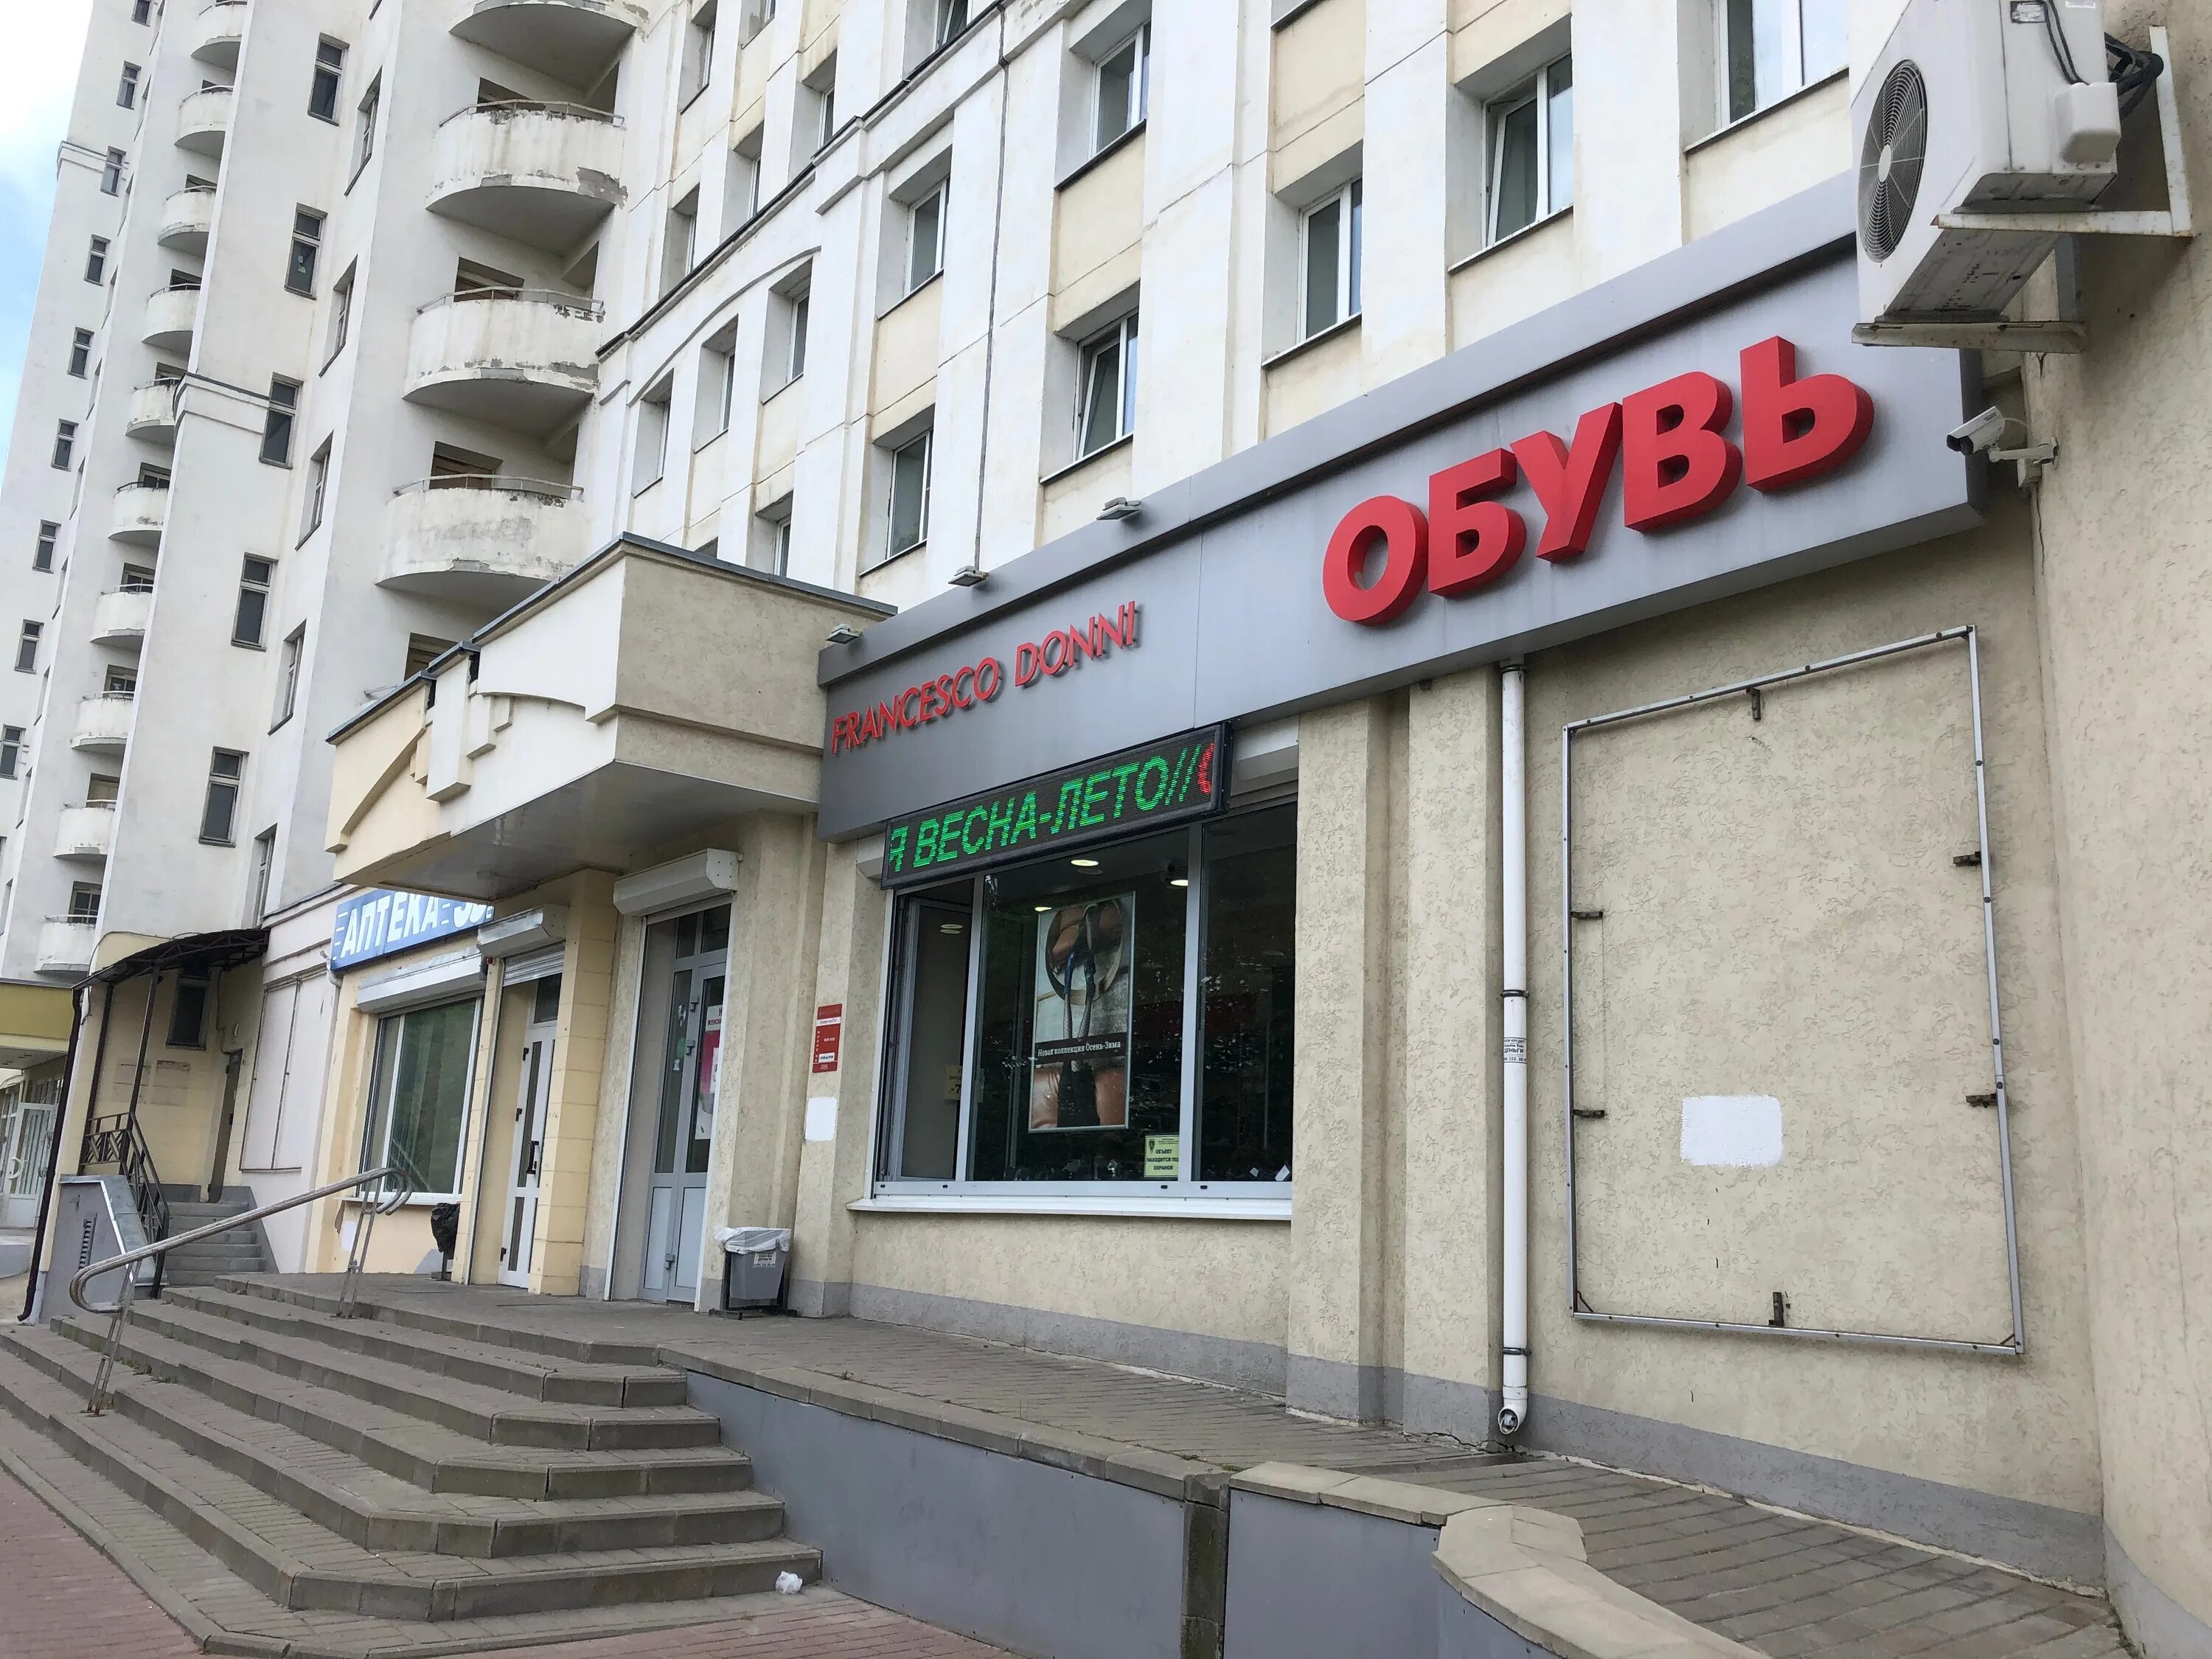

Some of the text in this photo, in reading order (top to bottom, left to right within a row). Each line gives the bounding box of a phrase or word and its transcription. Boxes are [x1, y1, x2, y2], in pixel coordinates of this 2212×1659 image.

[1322, 335, 1875, 625] ОБУВЬ
[831, 600, 1136, 754] FRANCESCO DONNI
[340, 891, 439, 959] АПТЕКА
[1037, 1041, 1121, 1057] Новая коллекция Осень-Зима
